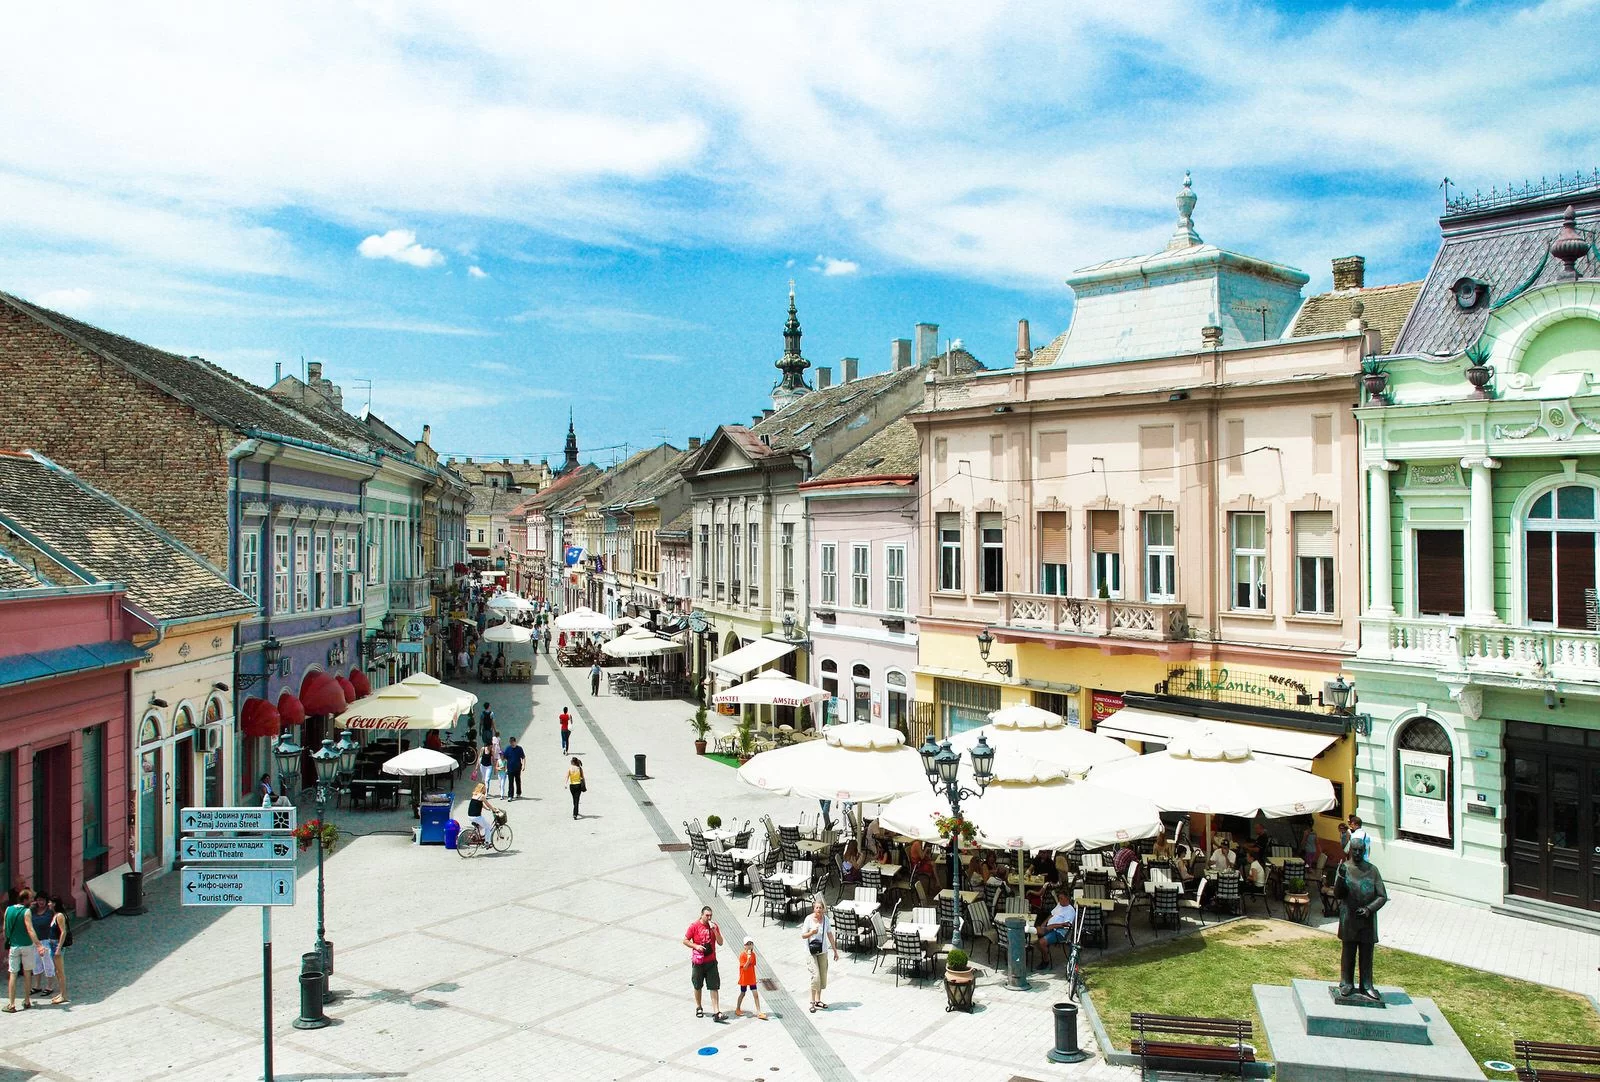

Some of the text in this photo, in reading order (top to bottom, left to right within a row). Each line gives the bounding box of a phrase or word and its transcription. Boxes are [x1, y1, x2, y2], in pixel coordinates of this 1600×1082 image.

[1210, 667, 1287, 703] Lanterna
[772, 697, 799, 706] AMSTEL
[197, 821, 214, 829] Zmaj
[197, 842, 236, 850] Позориште
[197, 850, 244, 858] Youth Theatre
[198, 872, 238, 881] Туристички
[198, 882, 243, 890] инфо-центар
[198, 894, 243, 902] Tourist Office
